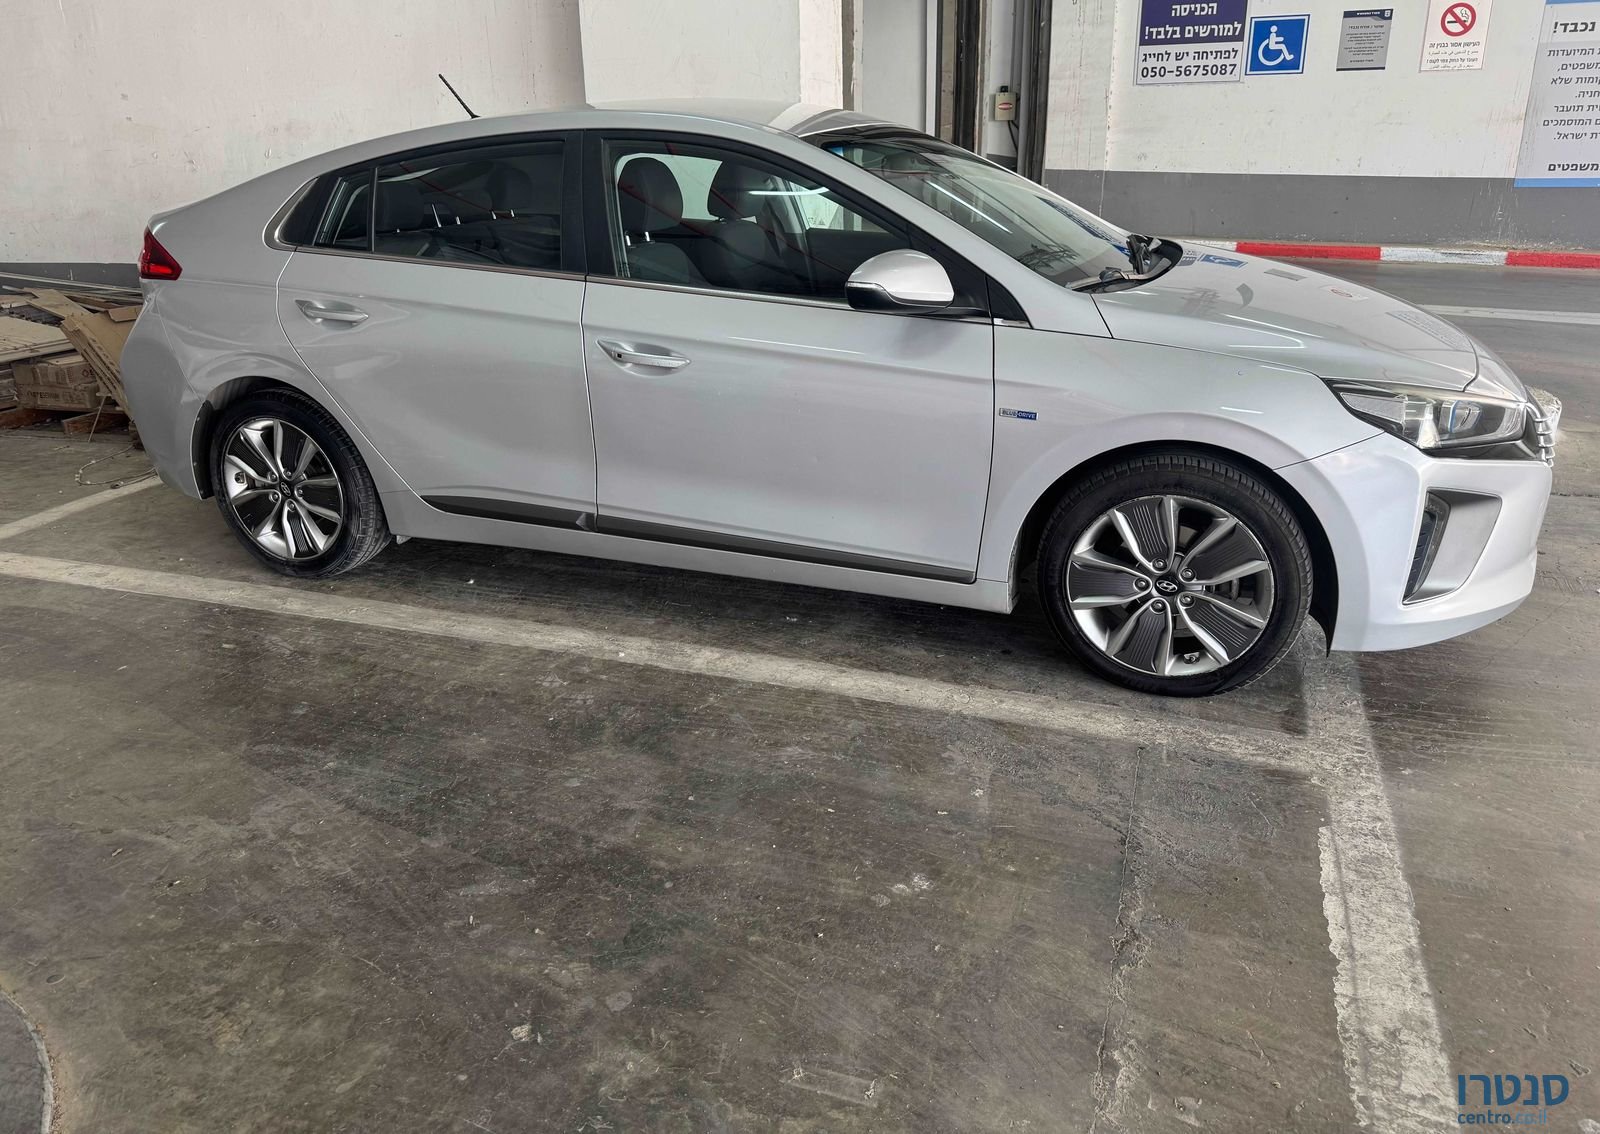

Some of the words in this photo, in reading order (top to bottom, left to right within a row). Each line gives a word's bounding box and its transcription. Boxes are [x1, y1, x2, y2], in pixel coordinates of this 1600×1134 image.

[1171, 2, 1218, 17] הכניסה
[1144, 24, 1181, 40] בלבד!
[1184, 21, 1242, 38] למורשים
[1553, 21, 1597, 33] נכבד!
[1141, 50, 1172, 63] לחייג
[1175, 50, 1190, 61] יש
[1192, 47, 1239, 61] לפתיחה
[1547, 47, 1595, 57] המיועדות
[1141, 63, 1238, 78] 050-5675087
[1550, 76, 1573, 85] שלא
[1554, 104, 1584, 113] תועבר
[1542, 118, 1592, 127] המוסמכים
[1553, 131, 1587, 141] ישראל.
[1547, 162, 1600, 172] משפטים
